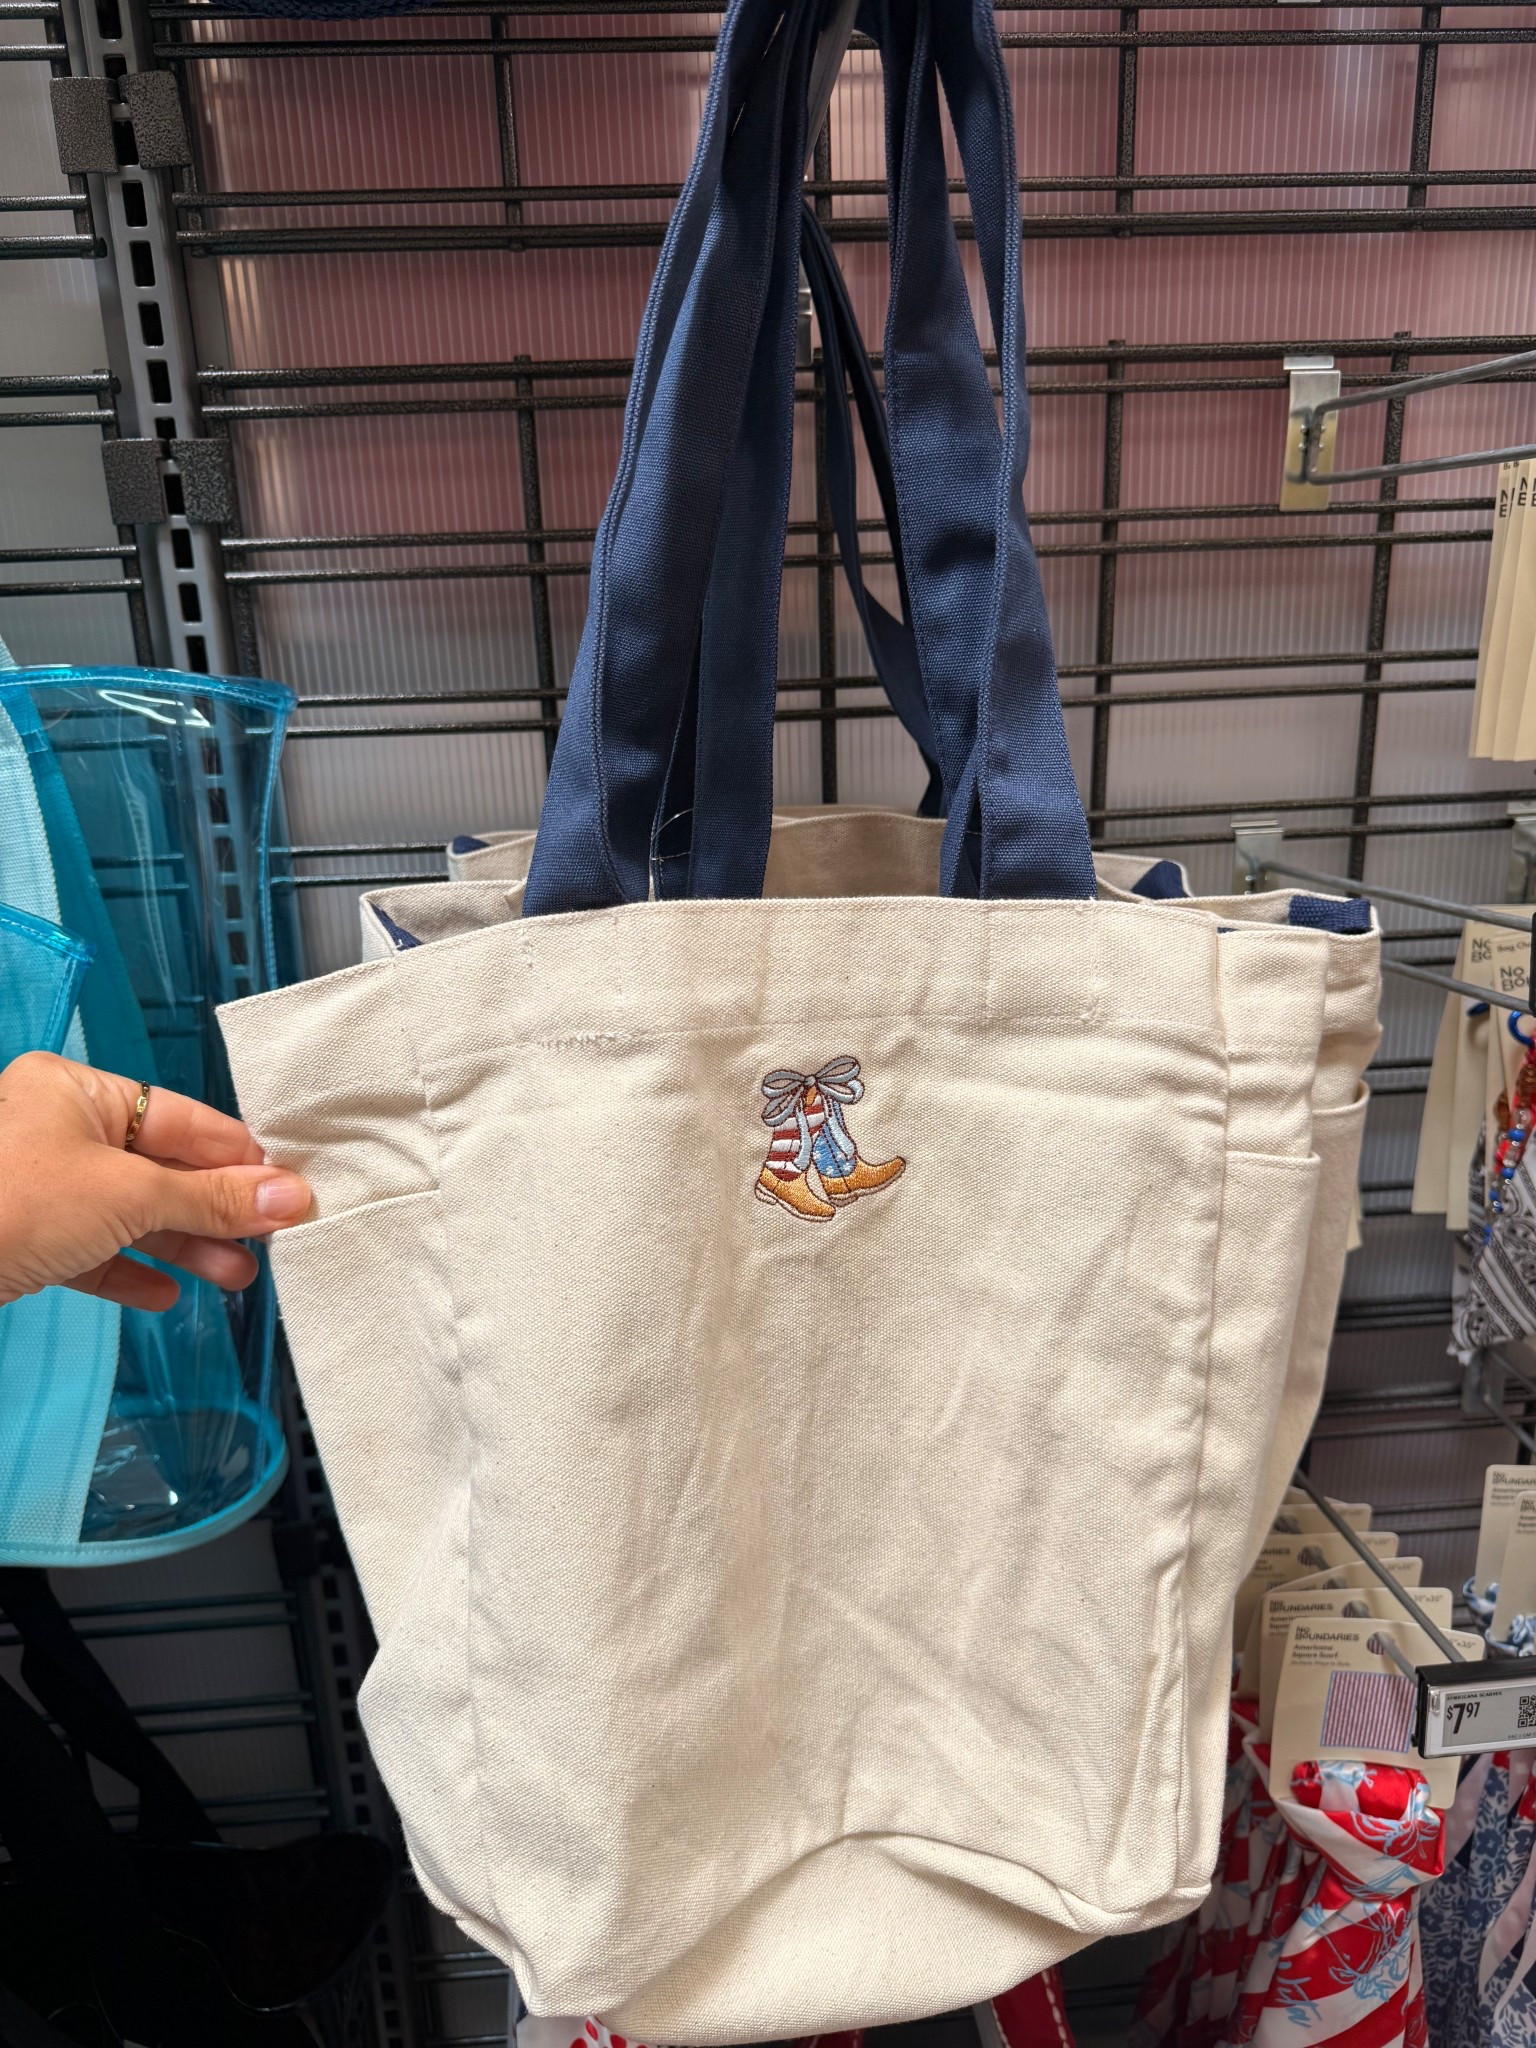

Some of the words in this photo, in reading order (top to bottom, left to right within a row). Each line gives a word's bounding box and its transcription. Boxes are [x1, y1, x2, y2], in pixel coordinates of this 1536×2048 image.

[1500, 966, 1524, 979] NO
[1269, 1603, 1333, 1613] BOUNDARIES
[1295, 1632, 1360, 1641] BOUNDARIES
